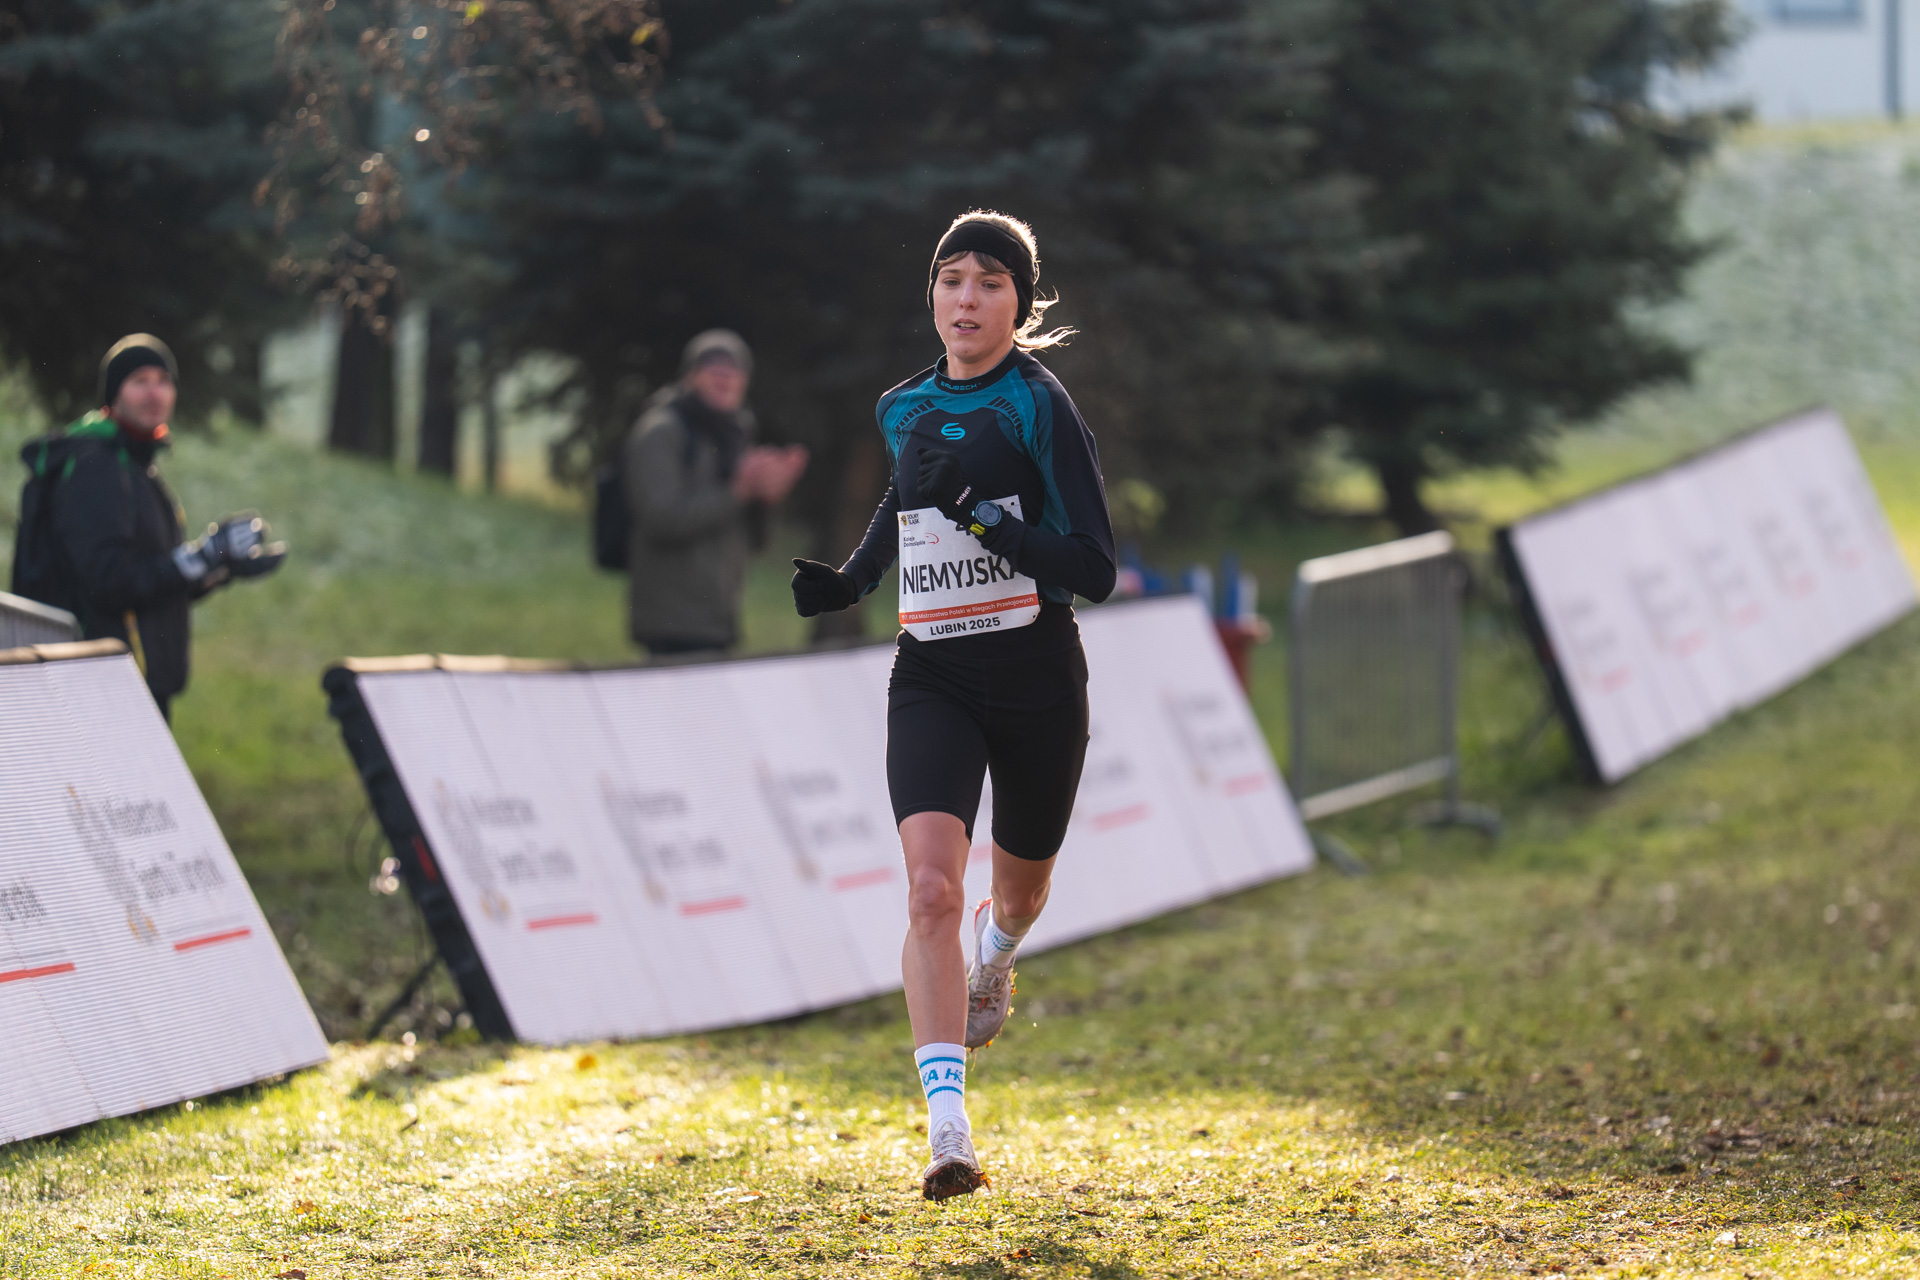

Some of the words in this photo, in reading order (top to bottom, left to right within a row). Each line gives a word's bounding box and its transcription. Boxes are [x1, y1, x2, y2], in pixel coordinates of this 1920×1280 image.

[940, 381, 977, 390] BRUBECK
[919, 611, 948, 619] Mistrzostwa
[972, 604, 996, 612] Biegach
[930, 622, 967, 635] LUBIN
[969, 617, 1001, 630] 2025
